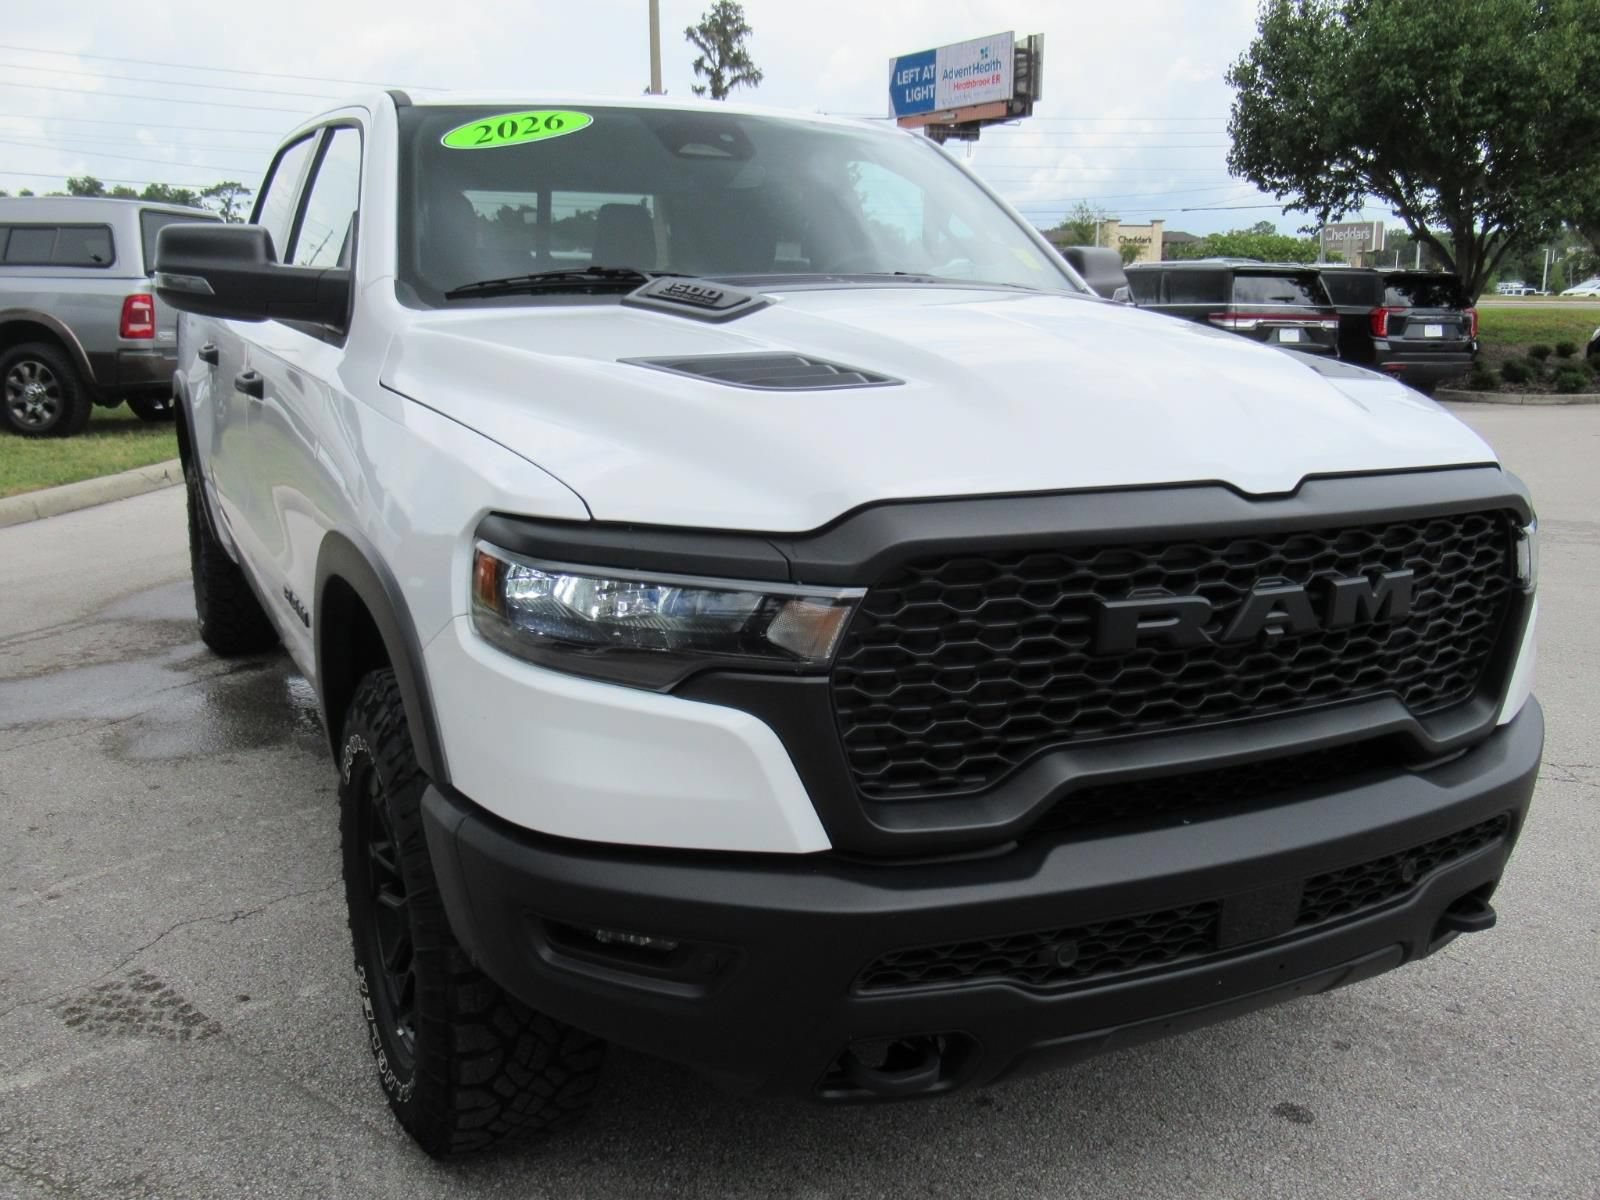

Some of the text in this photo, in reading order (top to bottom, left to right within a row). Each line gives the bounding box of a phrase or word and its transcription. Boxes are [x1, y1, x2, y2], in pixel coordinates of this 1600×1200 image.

[897, 63, 936, 86] LEFT AT
[942, 58, 1002, 81] AdventHealth
[991, 74, 1001, 85] ER
[905, 84, 936, 103] LIGHT
[473, 113, 565, 146] 2026
[1095, 568, 1415, 654] RAM
